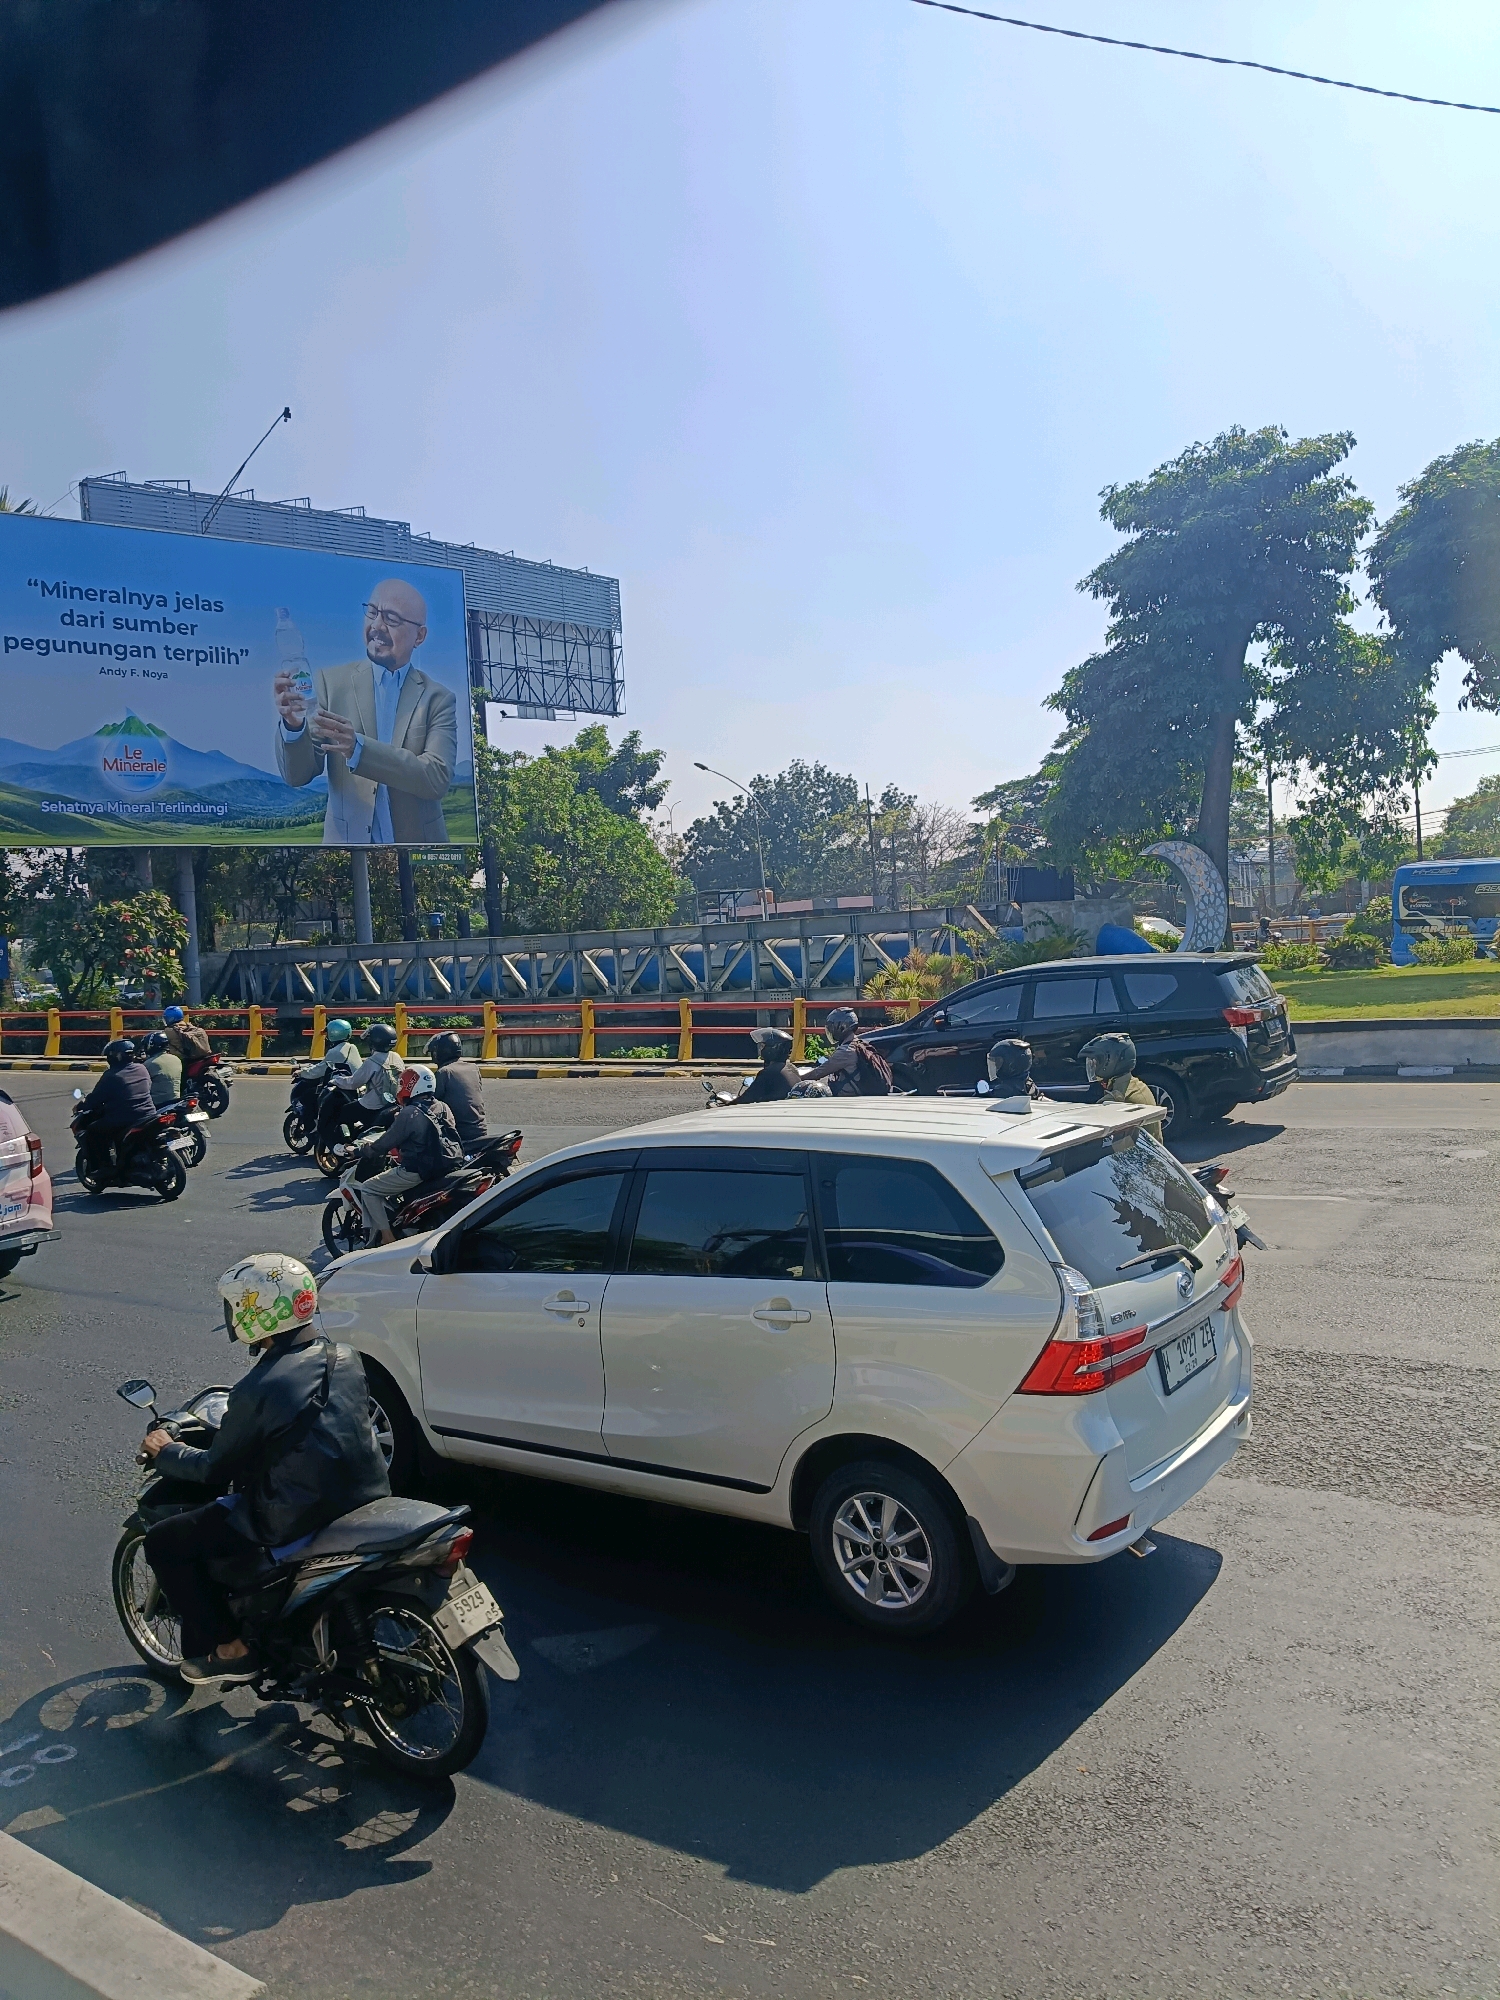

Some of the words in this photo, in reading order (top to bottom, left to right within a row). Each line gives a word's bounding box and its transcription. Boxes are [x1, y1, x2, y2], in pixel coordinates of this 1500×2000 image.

[27, 578, 169, 610] “Mineralnya
[173, 591, 225, 613] jelas
[60, 609, 105, 628] dari
[112, 617, 198, 636] sumber
[3, 635, 157, 661] pegunungan
[163, 644, 249, 667] terpilih”
[99, 667, 127, 678] Andy
[131, 669, 140, 677] F.
[142, 669, 169, 680] Noya
[124, 745, 142, 760] Le
[103, 757, 166, 773] Minerale
[41, 801, 104, 815] Sehatnya
[107, 801, 155, 813] Mineral
[158, 802, 228, 816] Terlindungi
[435, 1616, 449, 1630] L
[453, 1590, 485, 1617] 5929
